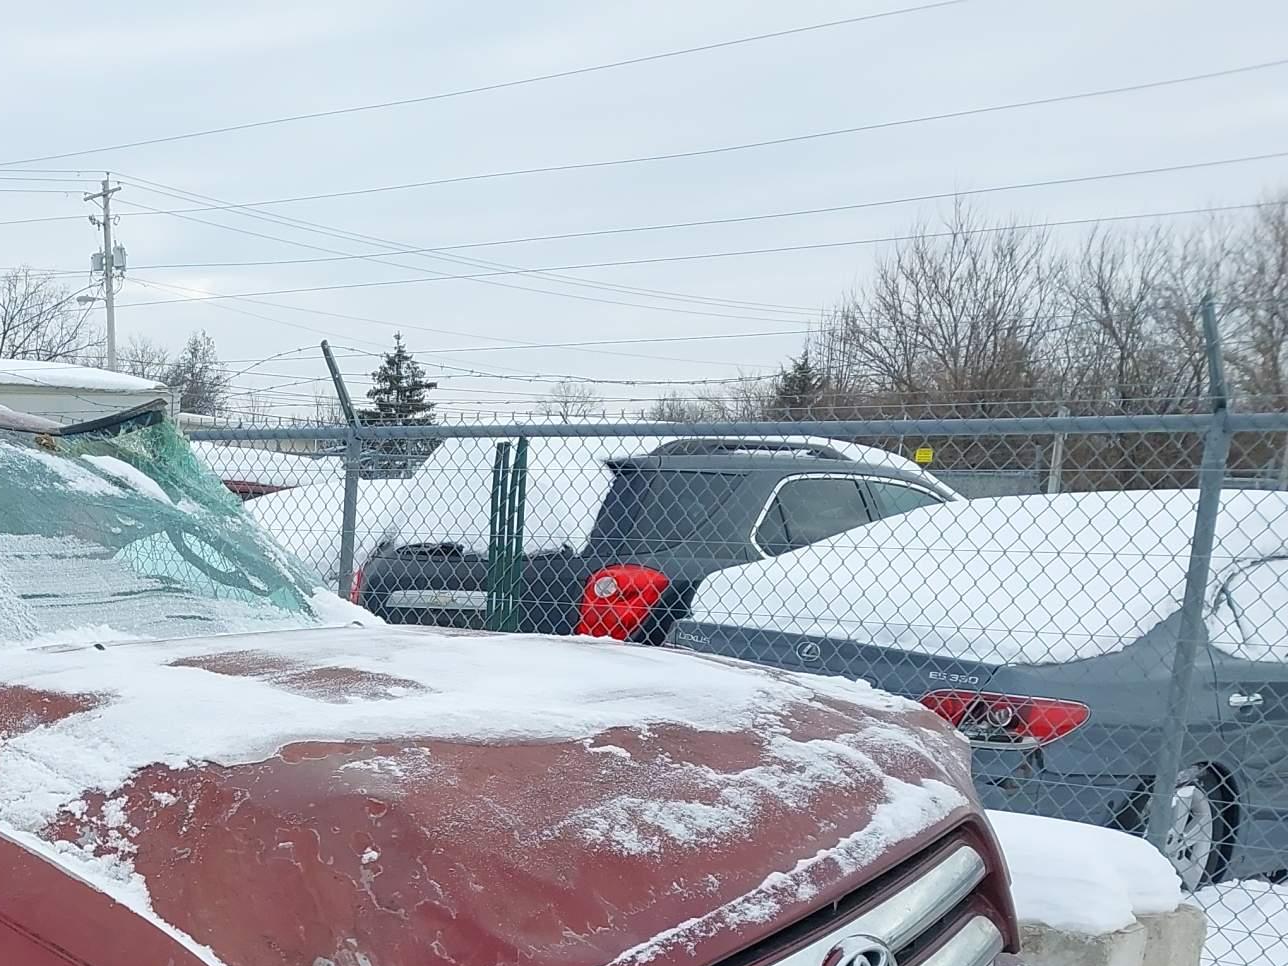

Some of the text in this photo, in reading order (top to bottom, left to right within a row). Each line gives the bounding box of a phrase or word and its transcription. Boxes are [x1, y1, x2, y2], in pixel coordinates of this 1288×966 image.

[678, 632, 711, 644] LEXUS
[928, 671, 980, 685] ES 330
